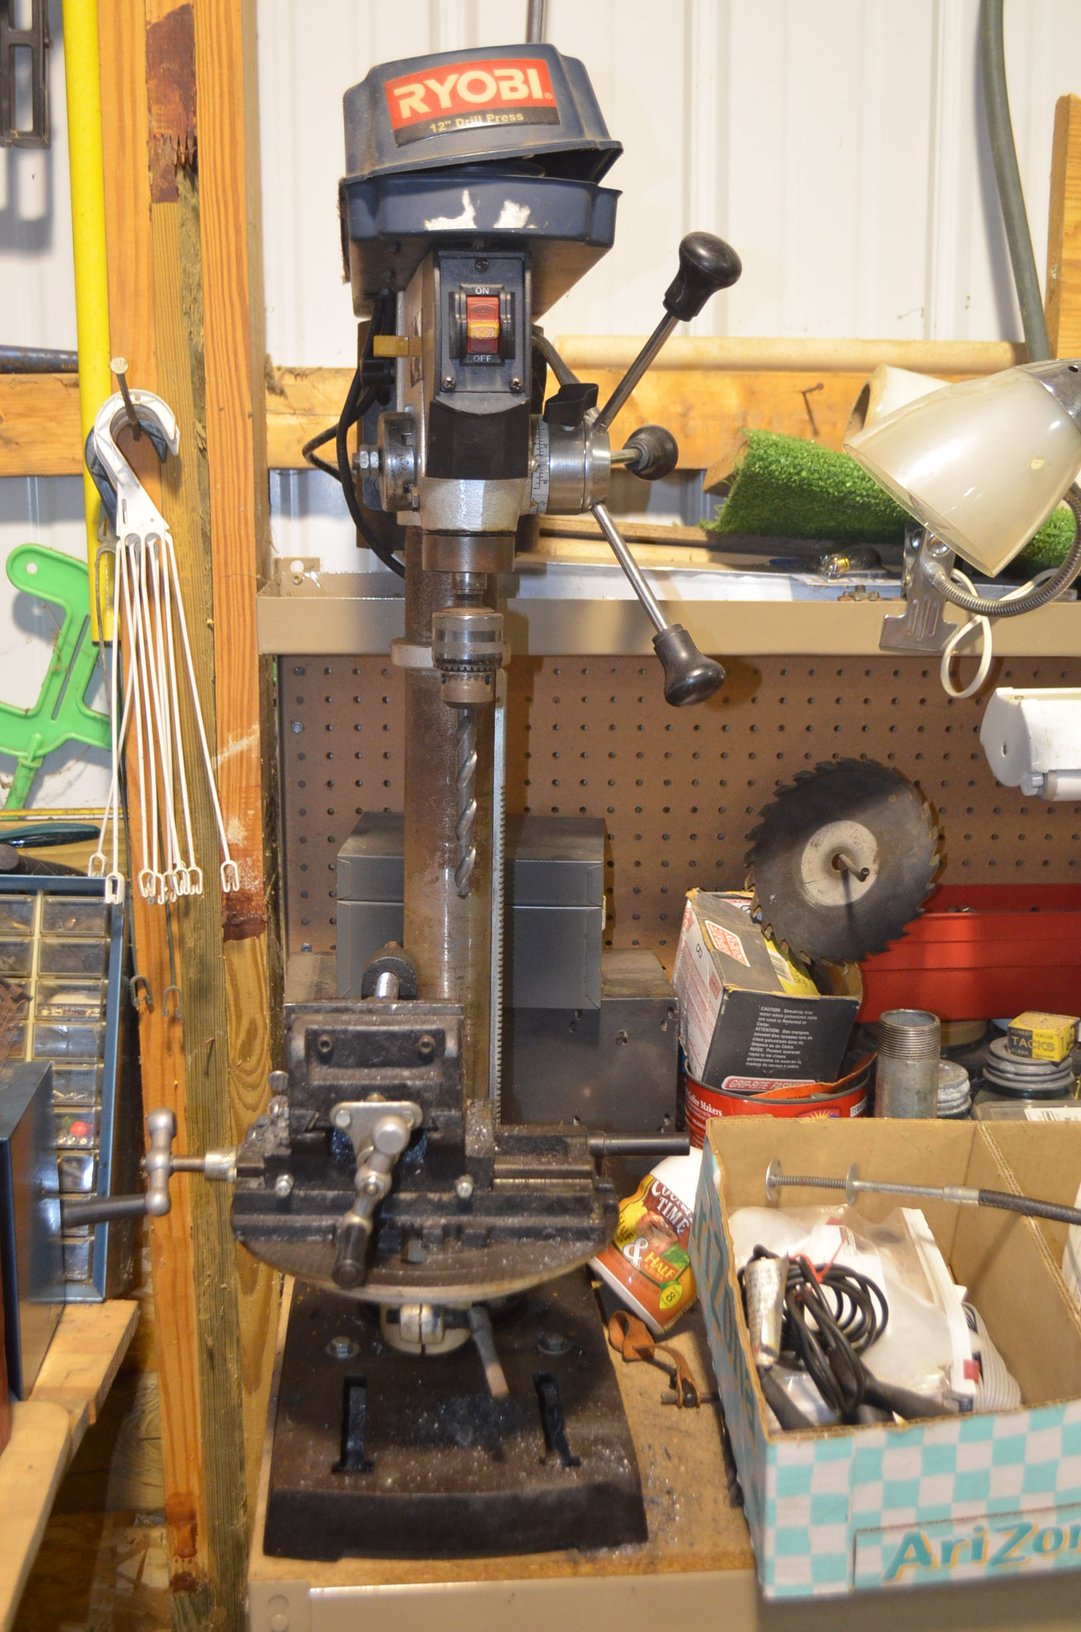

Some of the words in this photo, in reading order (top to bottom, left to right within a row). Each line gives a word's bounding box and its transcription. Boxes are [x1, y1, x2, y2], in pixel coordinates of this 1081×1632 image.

[394, 68, 546, 119] RYOBI
[430, 120, 452, 133] 12"
[455, 115, 482, 129] Drill
[486, 113, 524, 123] Press
[475, 286, 490, 296] ON
[473, 355, 492, 363] OFF
[1011, 1036, 1055, 1052] TACKS
[700, 1100, 723, 1117] Makers
[656, 1197, 690, 1234] TIME
[623, 1236, 649, 1270] &
[644, 1251, 676, 1279] HALF
[665, 1290, 676, 1302] 8
